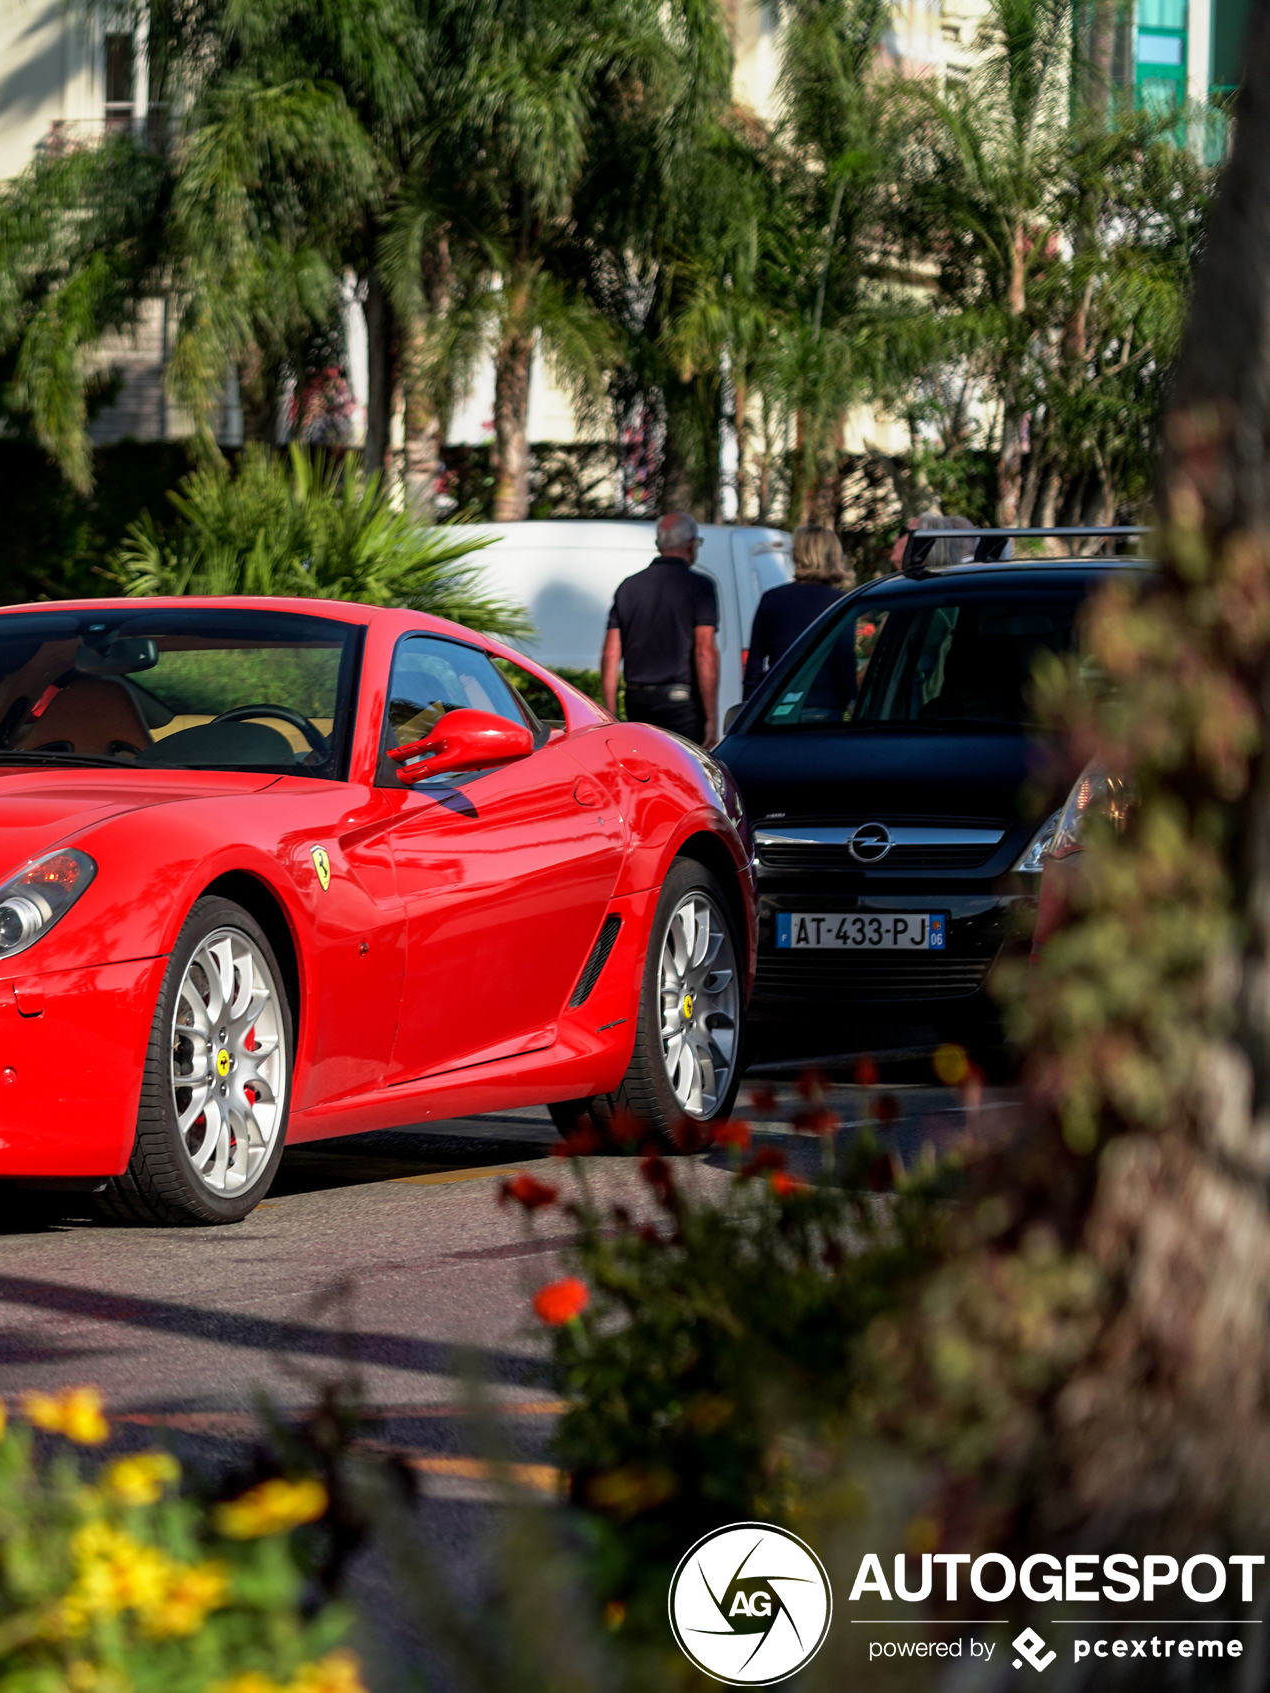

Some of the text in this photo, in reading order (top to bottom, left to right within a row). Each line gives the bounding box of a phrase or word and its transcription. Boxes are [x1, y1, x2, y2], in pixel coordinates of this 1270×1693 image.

[781, 933, 788, 943] F
[796, 917, 926, 946] AT-433-PJ
[930, 932, 943, 946] 06
